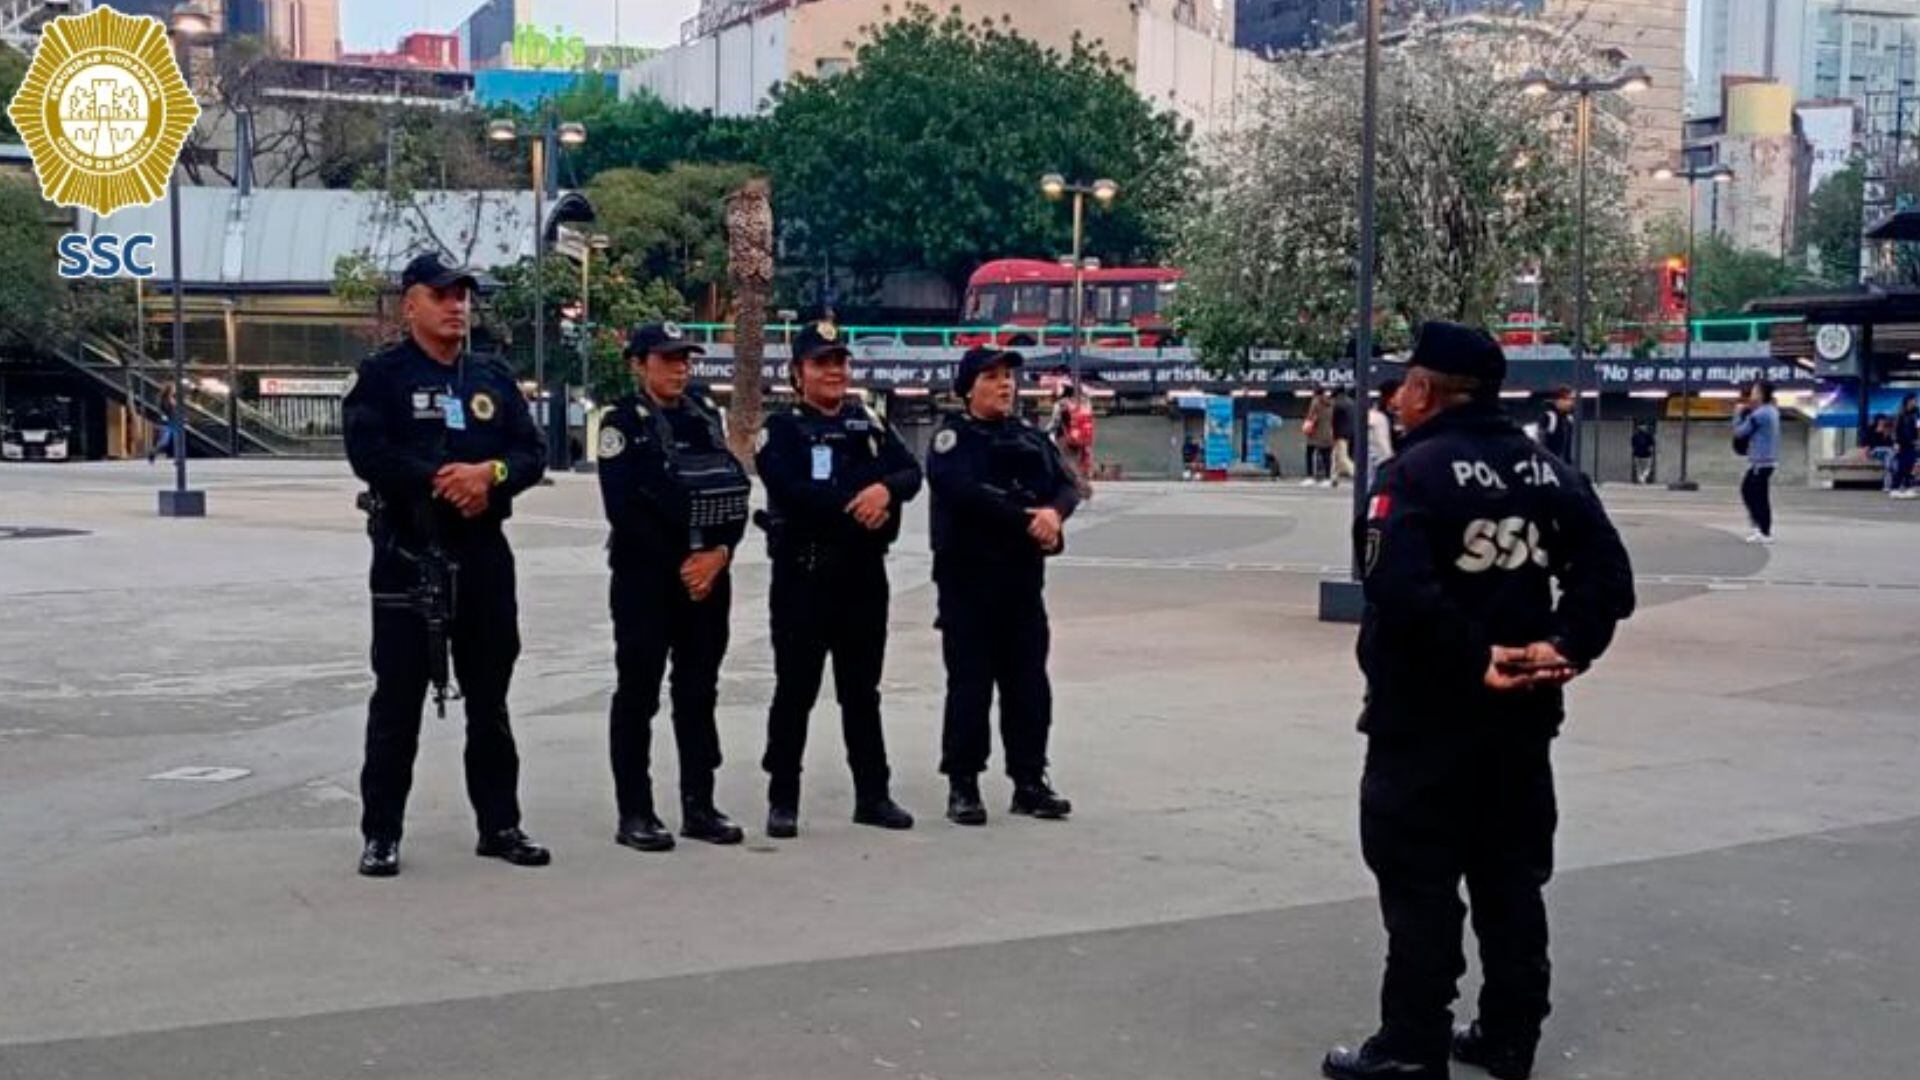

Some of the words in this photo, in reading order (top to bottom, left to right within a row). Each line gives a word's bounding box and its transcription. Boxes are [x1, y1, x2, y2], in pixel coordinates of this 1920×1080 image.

[513, 24, 586, 66] ibis
[1633, 366, 1655, 381] se
[1658, 366, 1704, 381] nae
[1452, 454, 1560, 489] POLCÍA
